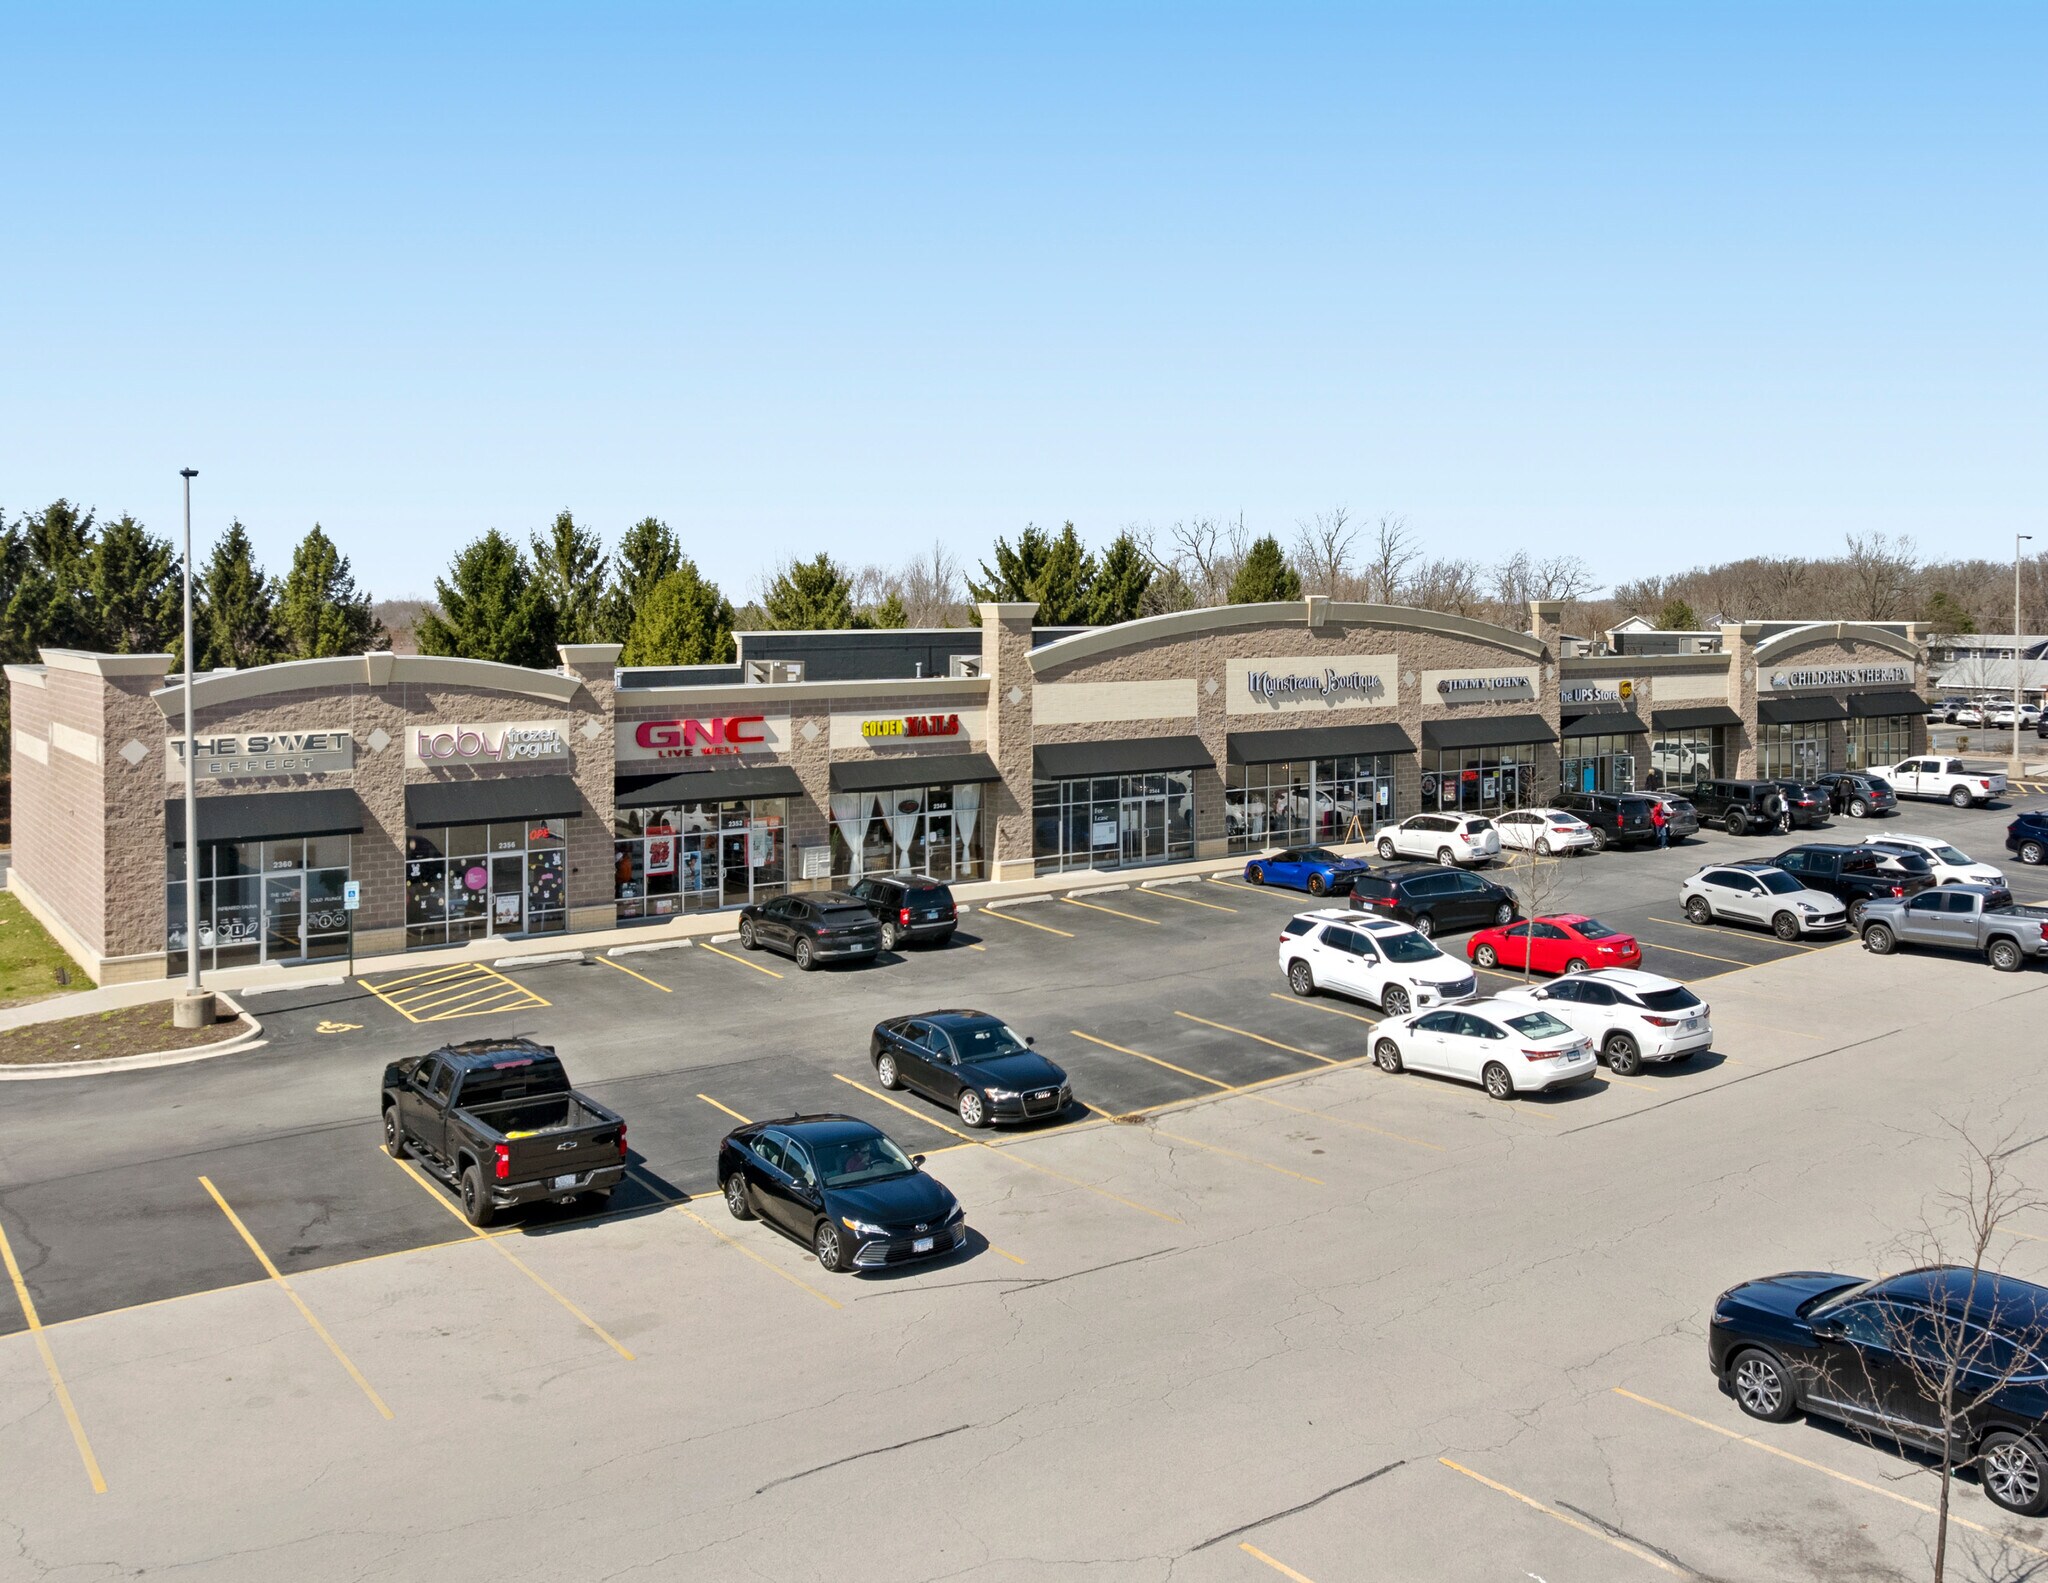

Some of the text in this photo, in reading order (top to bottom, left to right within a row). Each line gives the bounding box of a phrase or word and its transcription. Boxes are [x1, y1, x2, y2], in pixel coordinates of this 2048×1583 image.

[1247, 668, 1380, 698] Mainstream Boutique
[1448, 676, 1529, 693] JIMMY JOHN'S
[1790, 668, 1907, 686] CHILDREN'S THERAPY
[1560, 688, 1618, 703] he UPS Store
[635, 716, 764, 748] GNC
[862, 714, 959, 737] GOLDEN NAILS
[418, 725, 506, 762] tcby
[508, 727, 560, 743] frozen
[170, 737, 236, 757] THE
[507, 740, 561, 760] yogurt
[658, 746, 742, 758] LIVE WELL
[209, 758, 313, 773] EFFECT
[498, 841, 516, 849] 2356
[273, 860, 293, 868] 2360
